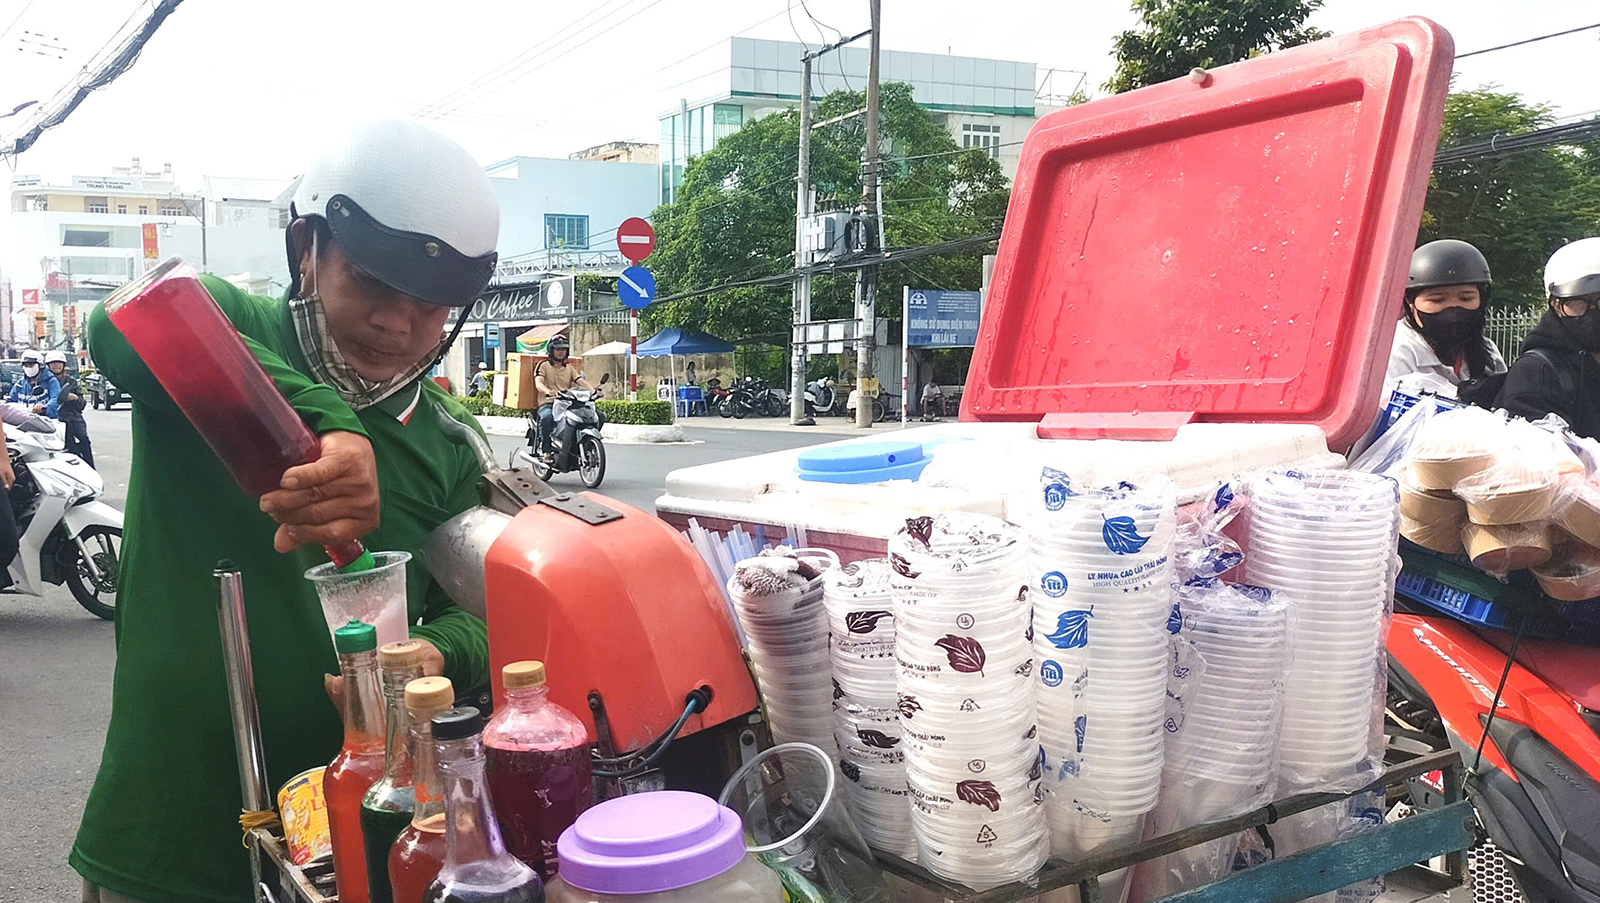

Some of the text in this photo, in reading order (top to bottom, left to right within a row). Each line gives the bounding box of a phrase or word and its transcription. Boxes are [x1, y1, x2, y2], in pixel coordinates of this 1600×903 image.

[487, 290, 534, 320] Coffee
[910, 316, 978, 332] KHÔNG SỬ DỤNG ĐIỆN THOẠI
[931, 331, 957, 343] KHI LÁI XE
[1087, 572, 1096, 580] LY
[1120, 569, 1134, 578] CAO
[1092, 580, 1111, 588] HIGH
[1112, 577, 1141, 587] QUALITY
[983, 831, 990, 839] 5
